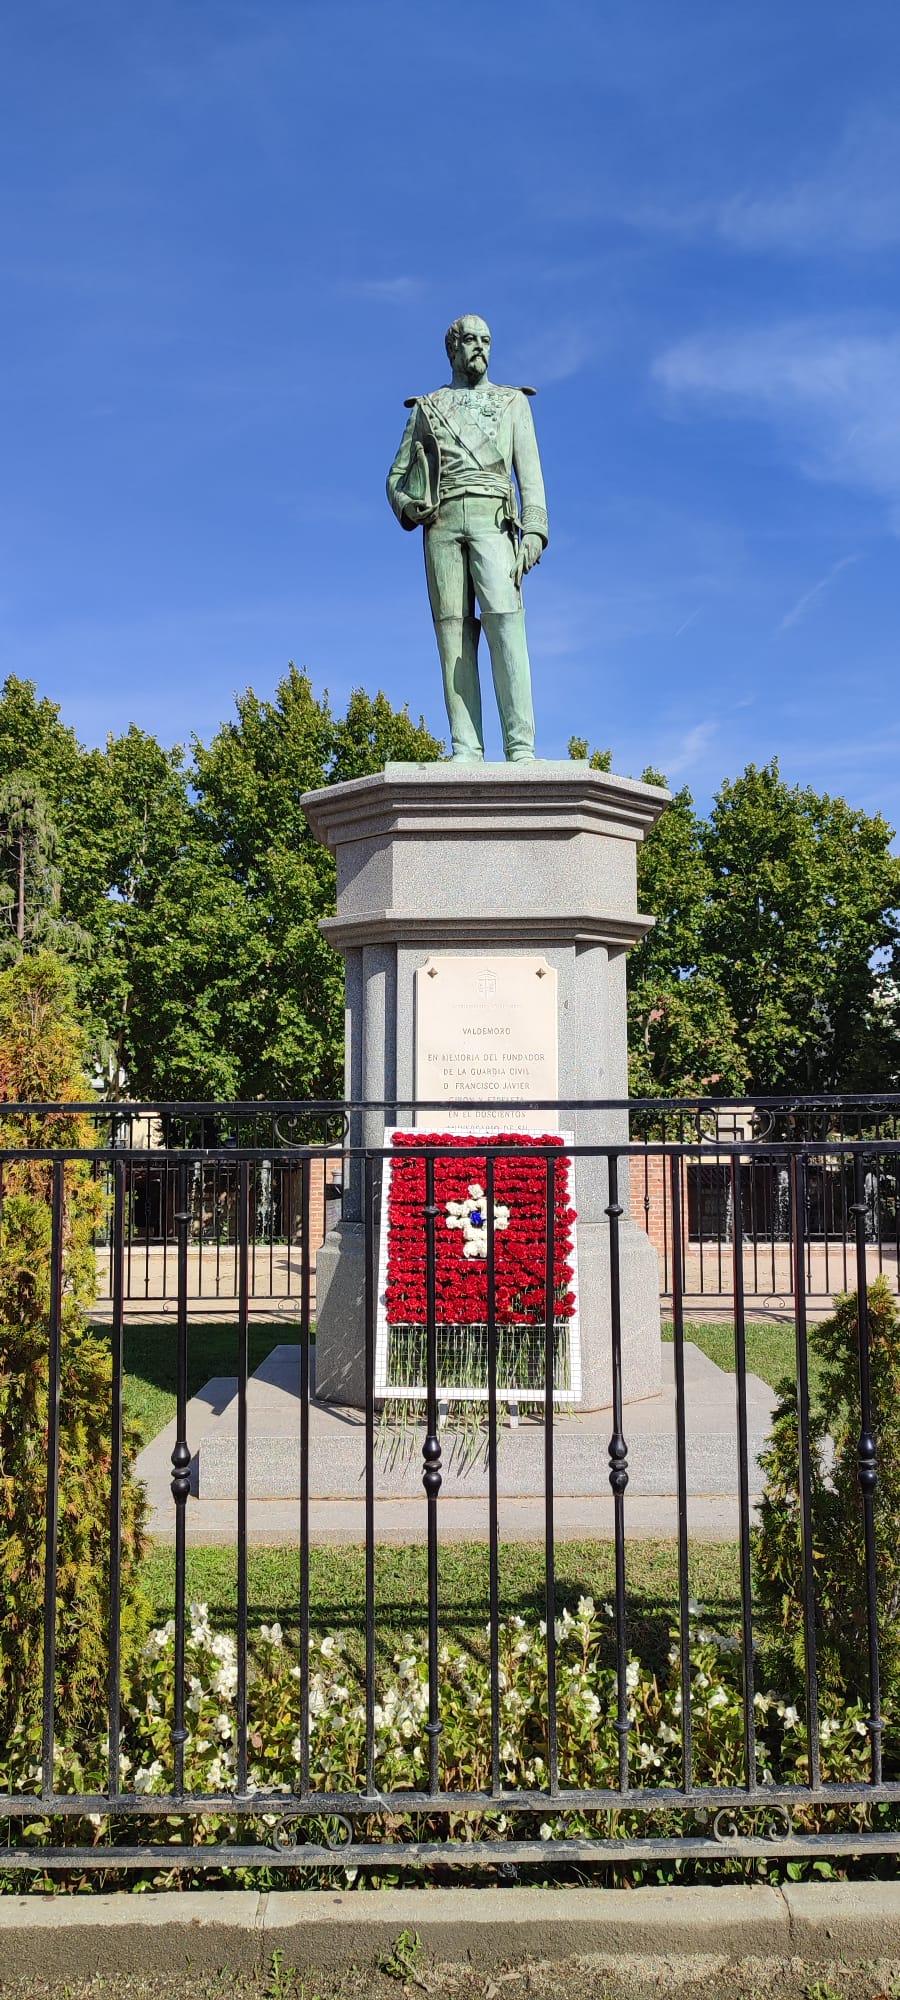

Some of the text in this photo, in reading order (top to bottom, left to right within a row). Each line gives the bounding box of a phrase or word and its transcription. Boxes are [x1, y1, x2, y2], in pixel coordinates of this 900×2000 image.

[462, 1027, 511, 1035] VALDEMORO
[427, 1053, 545, 1062] EN MEMORIA DEL FUNDADOR
[443, 1067, 531, 1076] DE LA GUARDIA CIVIL
[455, 1082, 500, 1090] FRANCISCO
[503, 1082, 531, 1090] JAVIER
[475, 1110, 527, 1118] DOSCIENTOS
